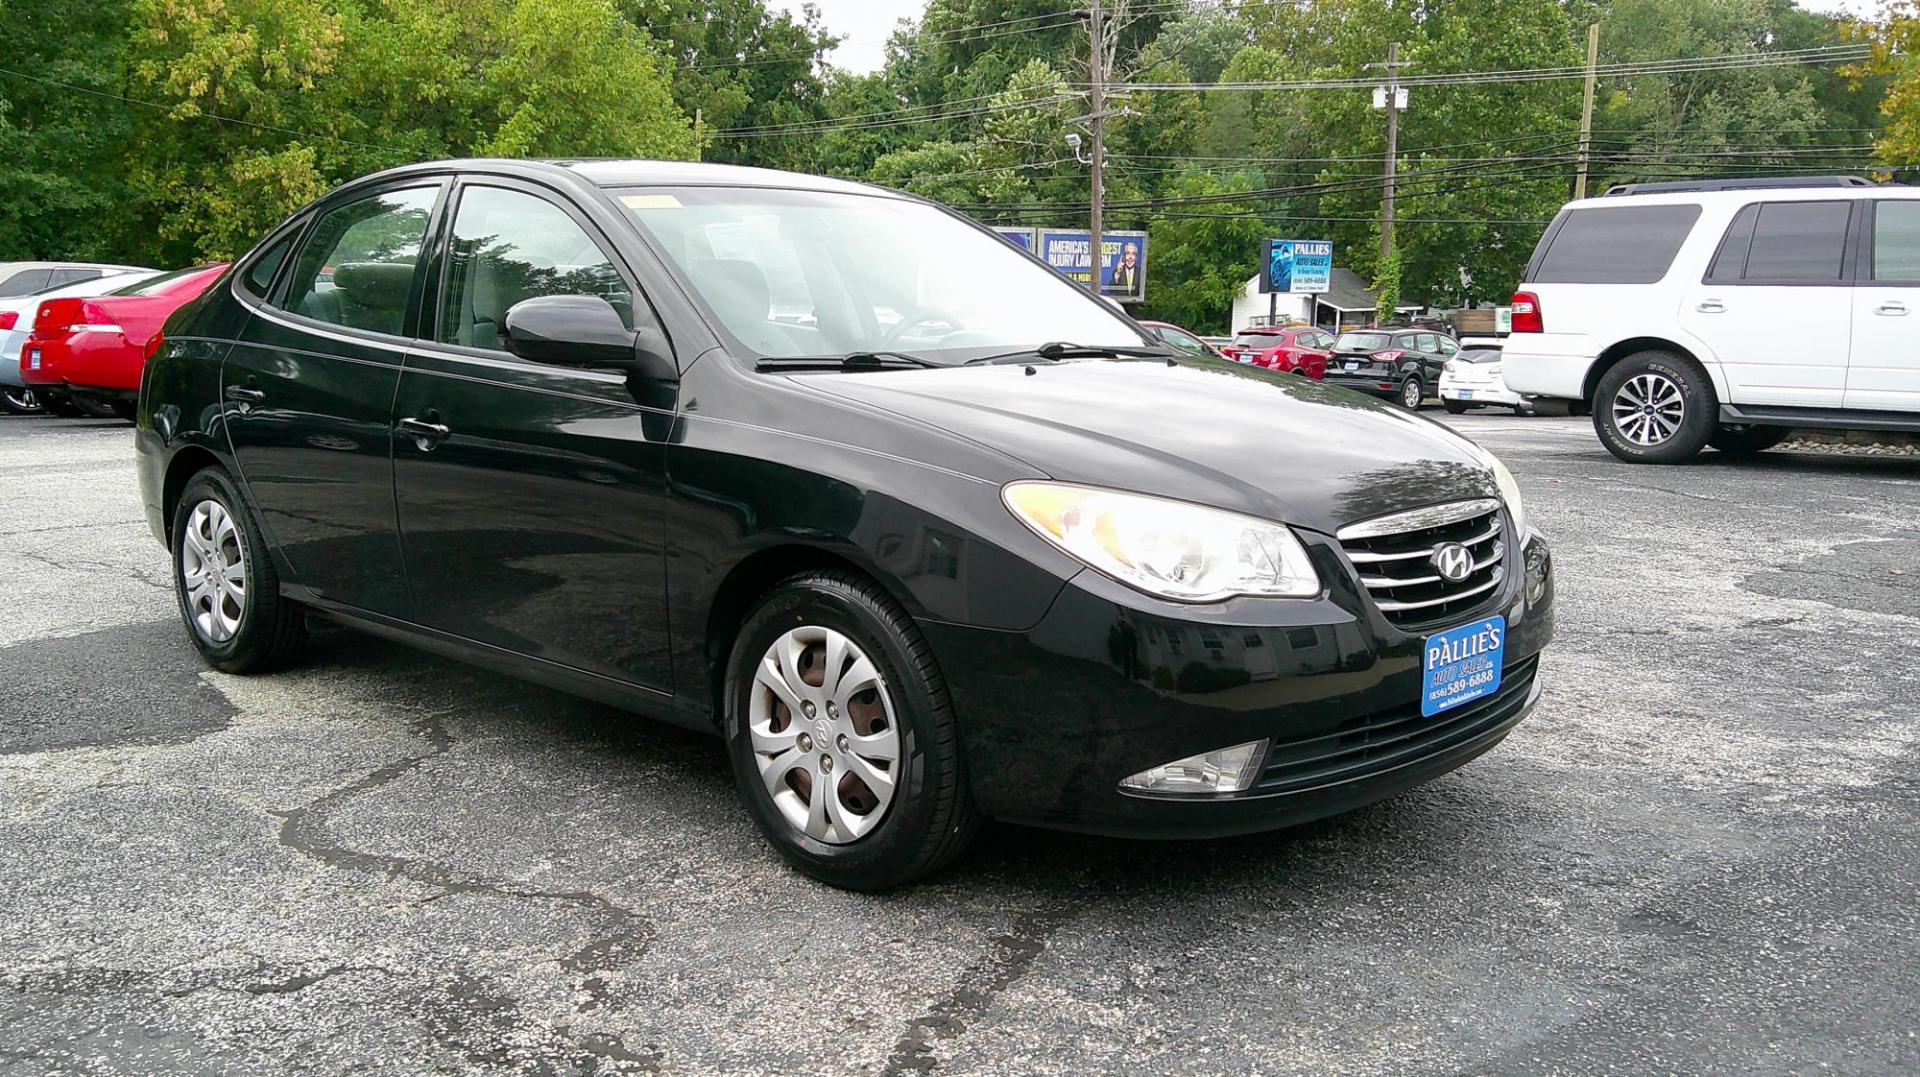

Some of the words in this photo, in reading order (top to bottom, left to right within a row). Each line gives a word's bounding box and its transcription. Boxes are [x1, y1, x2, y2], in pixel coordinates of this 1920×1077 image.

[1049, 240, 1089, 254] AMERICA'S
[1090, 241, 1122, 255] GEST
[1049, 254, 1074, 267] INJURY
[1648, 363, 1692, 398] GENERAL
[1432, 666, 1457, 686] AUTO
[1459, 656, 1487, 678] SALES
